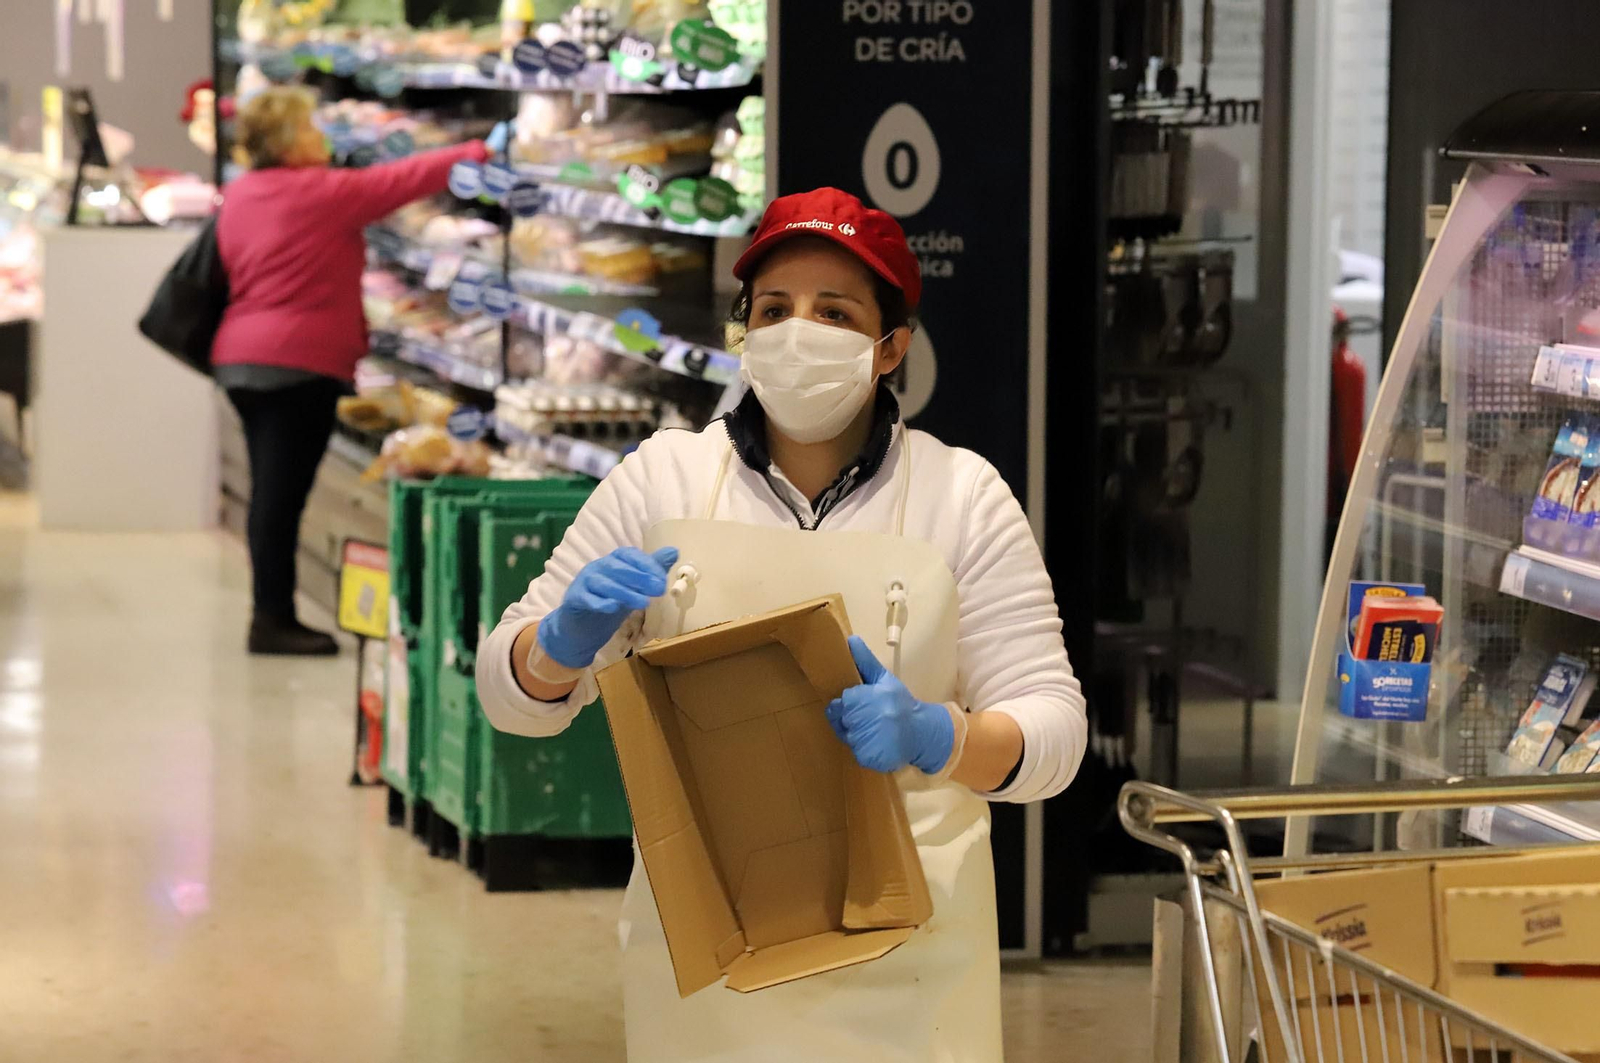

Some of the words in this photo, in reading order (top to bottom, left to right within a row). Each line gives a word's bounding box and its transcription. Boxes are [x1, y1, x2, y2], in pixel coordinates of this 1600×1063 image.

[843, 0, 900, 23] POR
[906, 0, 973, 24] TIPO
[855, 37, 894, 61] DE
[899, 31, 966, 61] CRÍA
[886, 141, 918, 189] 0
[919, 255, 954, 277] ica
